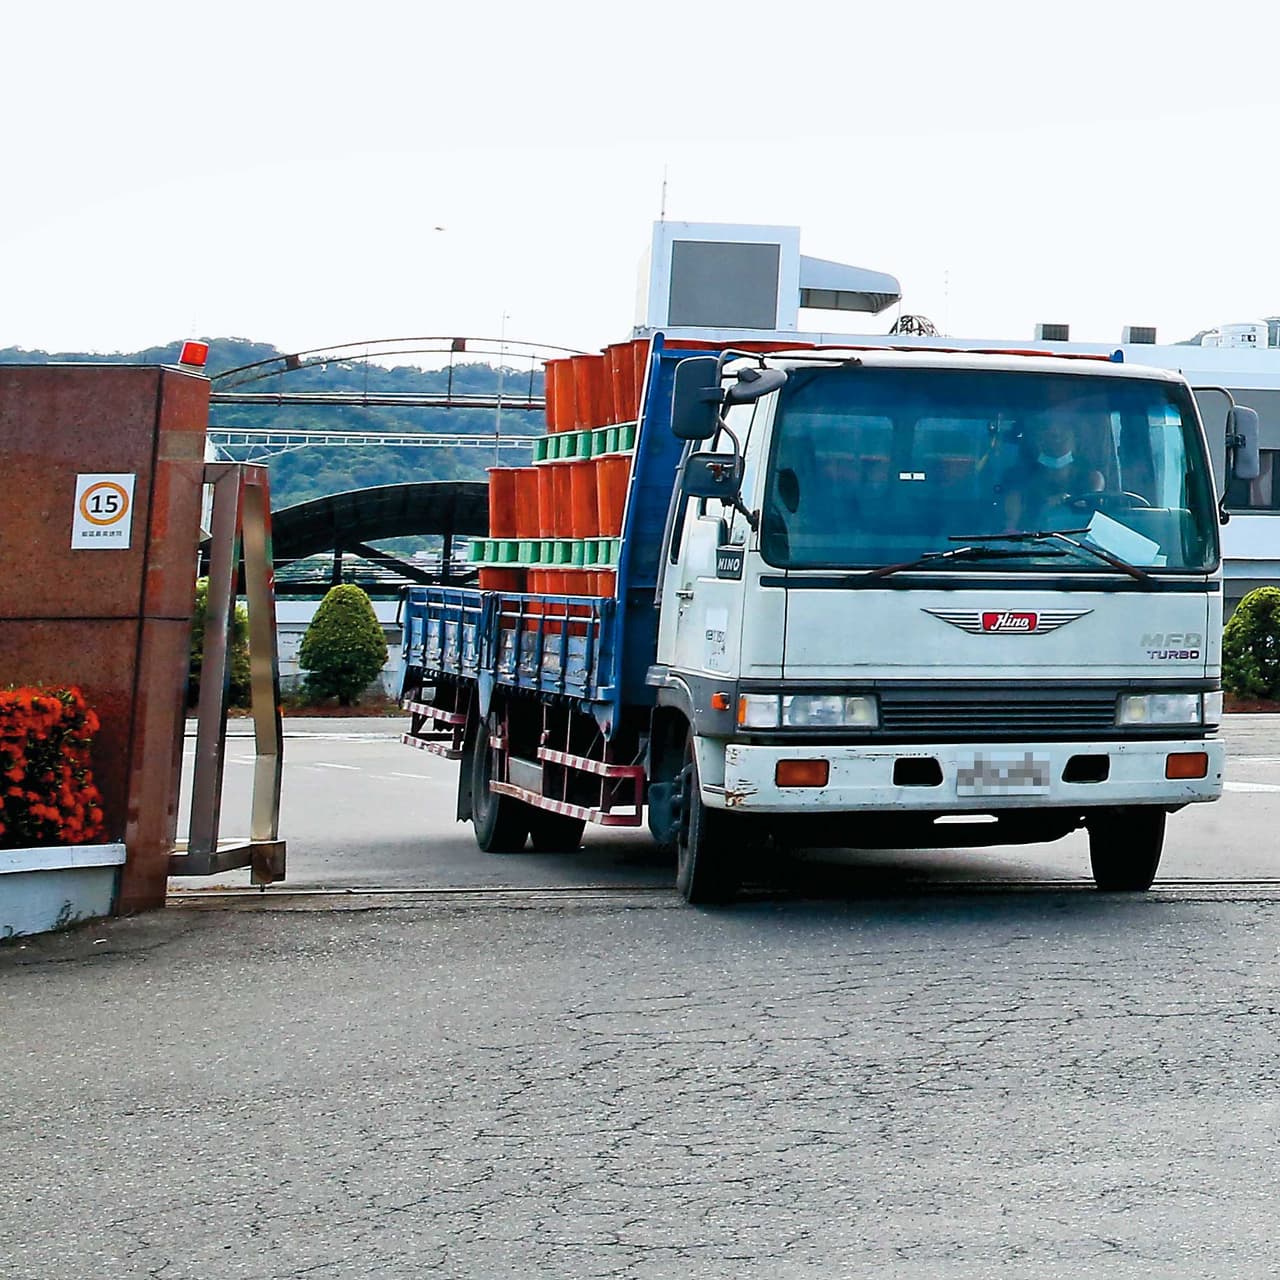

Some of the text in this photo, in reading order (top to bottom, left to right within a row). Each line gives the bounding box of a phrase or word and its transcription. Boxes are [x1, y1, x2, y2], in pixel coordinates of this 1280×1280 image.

[90, 495, 118, 513] 15
[990, 613, 1030, 630] Hino
[1146, 650, 1200, 660] TURBO
